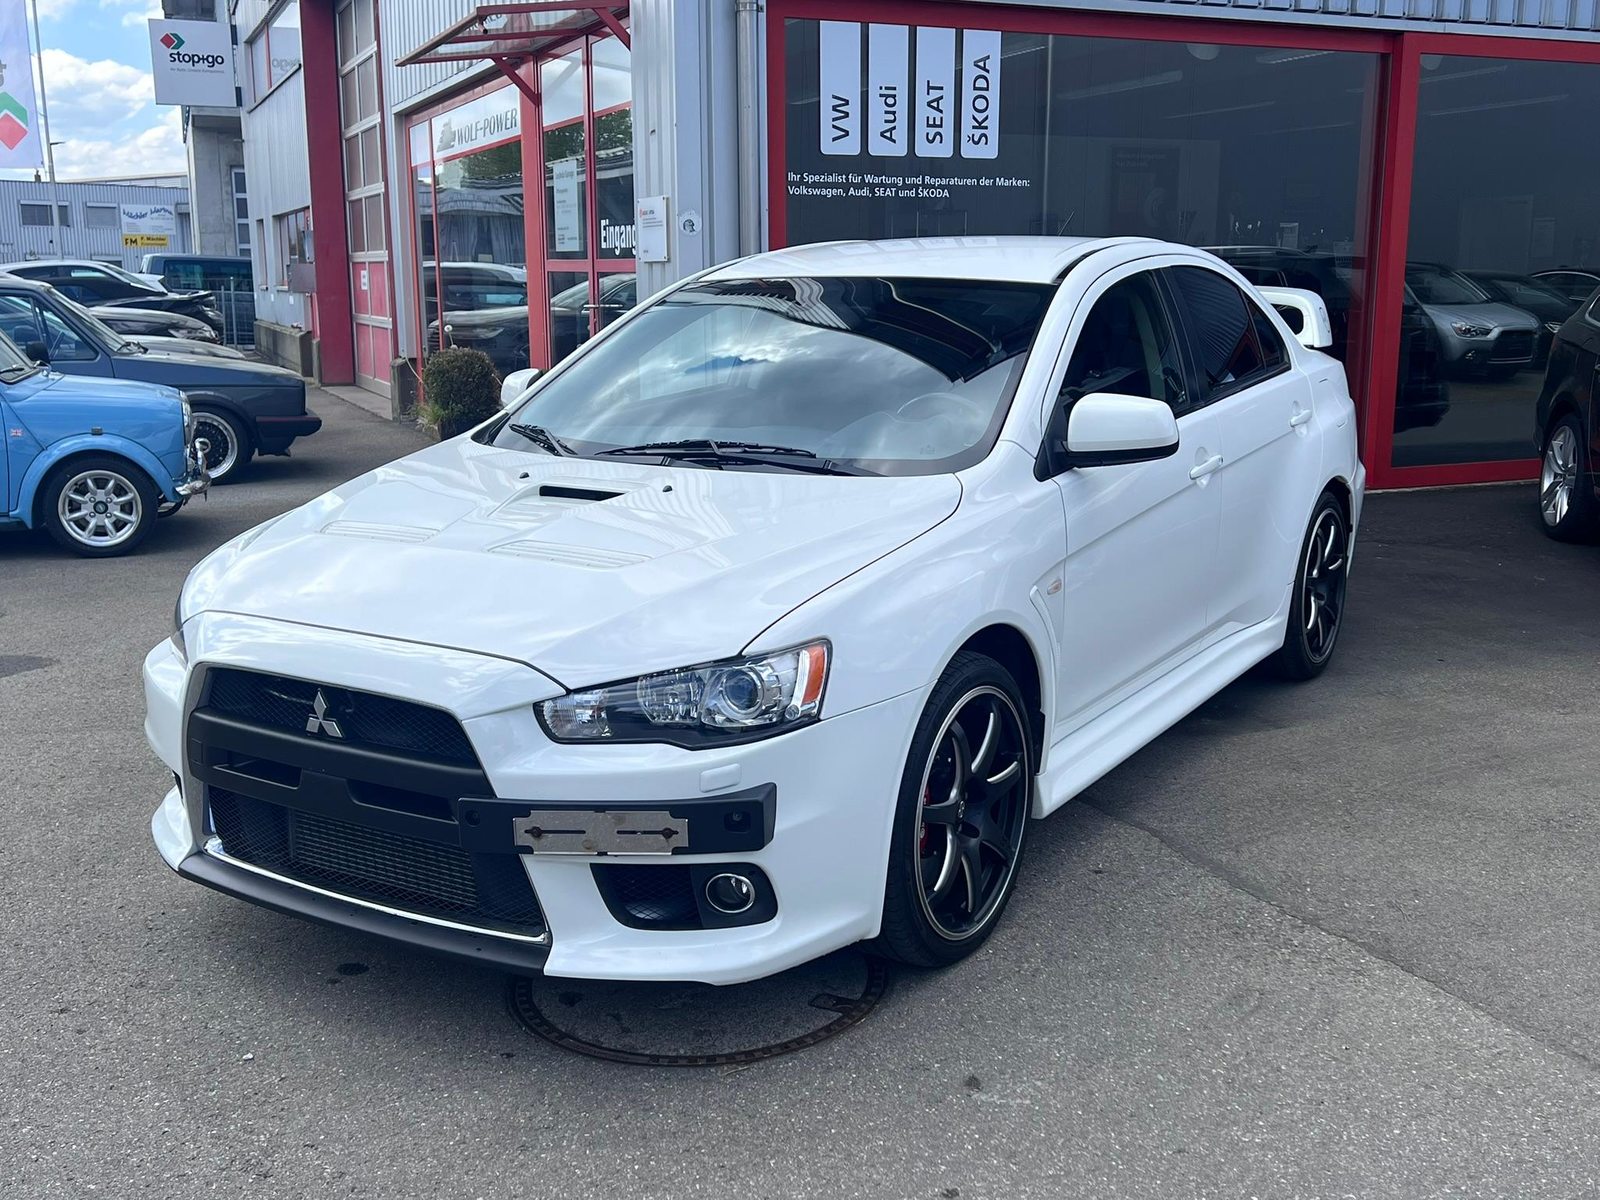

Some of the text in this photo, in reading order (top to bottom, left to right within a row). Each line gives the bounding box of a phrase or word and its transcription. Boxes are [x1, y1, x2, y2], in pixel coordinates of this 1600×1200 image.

[169, 51, 225, 68] stop+go
[831, 94, 850, 143] VW
[879, 85, 898, 144] Audi
[926, 80, 945, 144] SEAT
[966, 54, 991, 146] ŠKODA
[457, 107, 518, 145] WOLF-POWER
[788, 172, 1030, 187] Ihr Spezialist für Wartung und Reparaturen der Marken:
[788, 186, 950, 198] Volkswagen, Audi, SEAT und ŠKODA
[600, 218, 637, 256] Eingang
